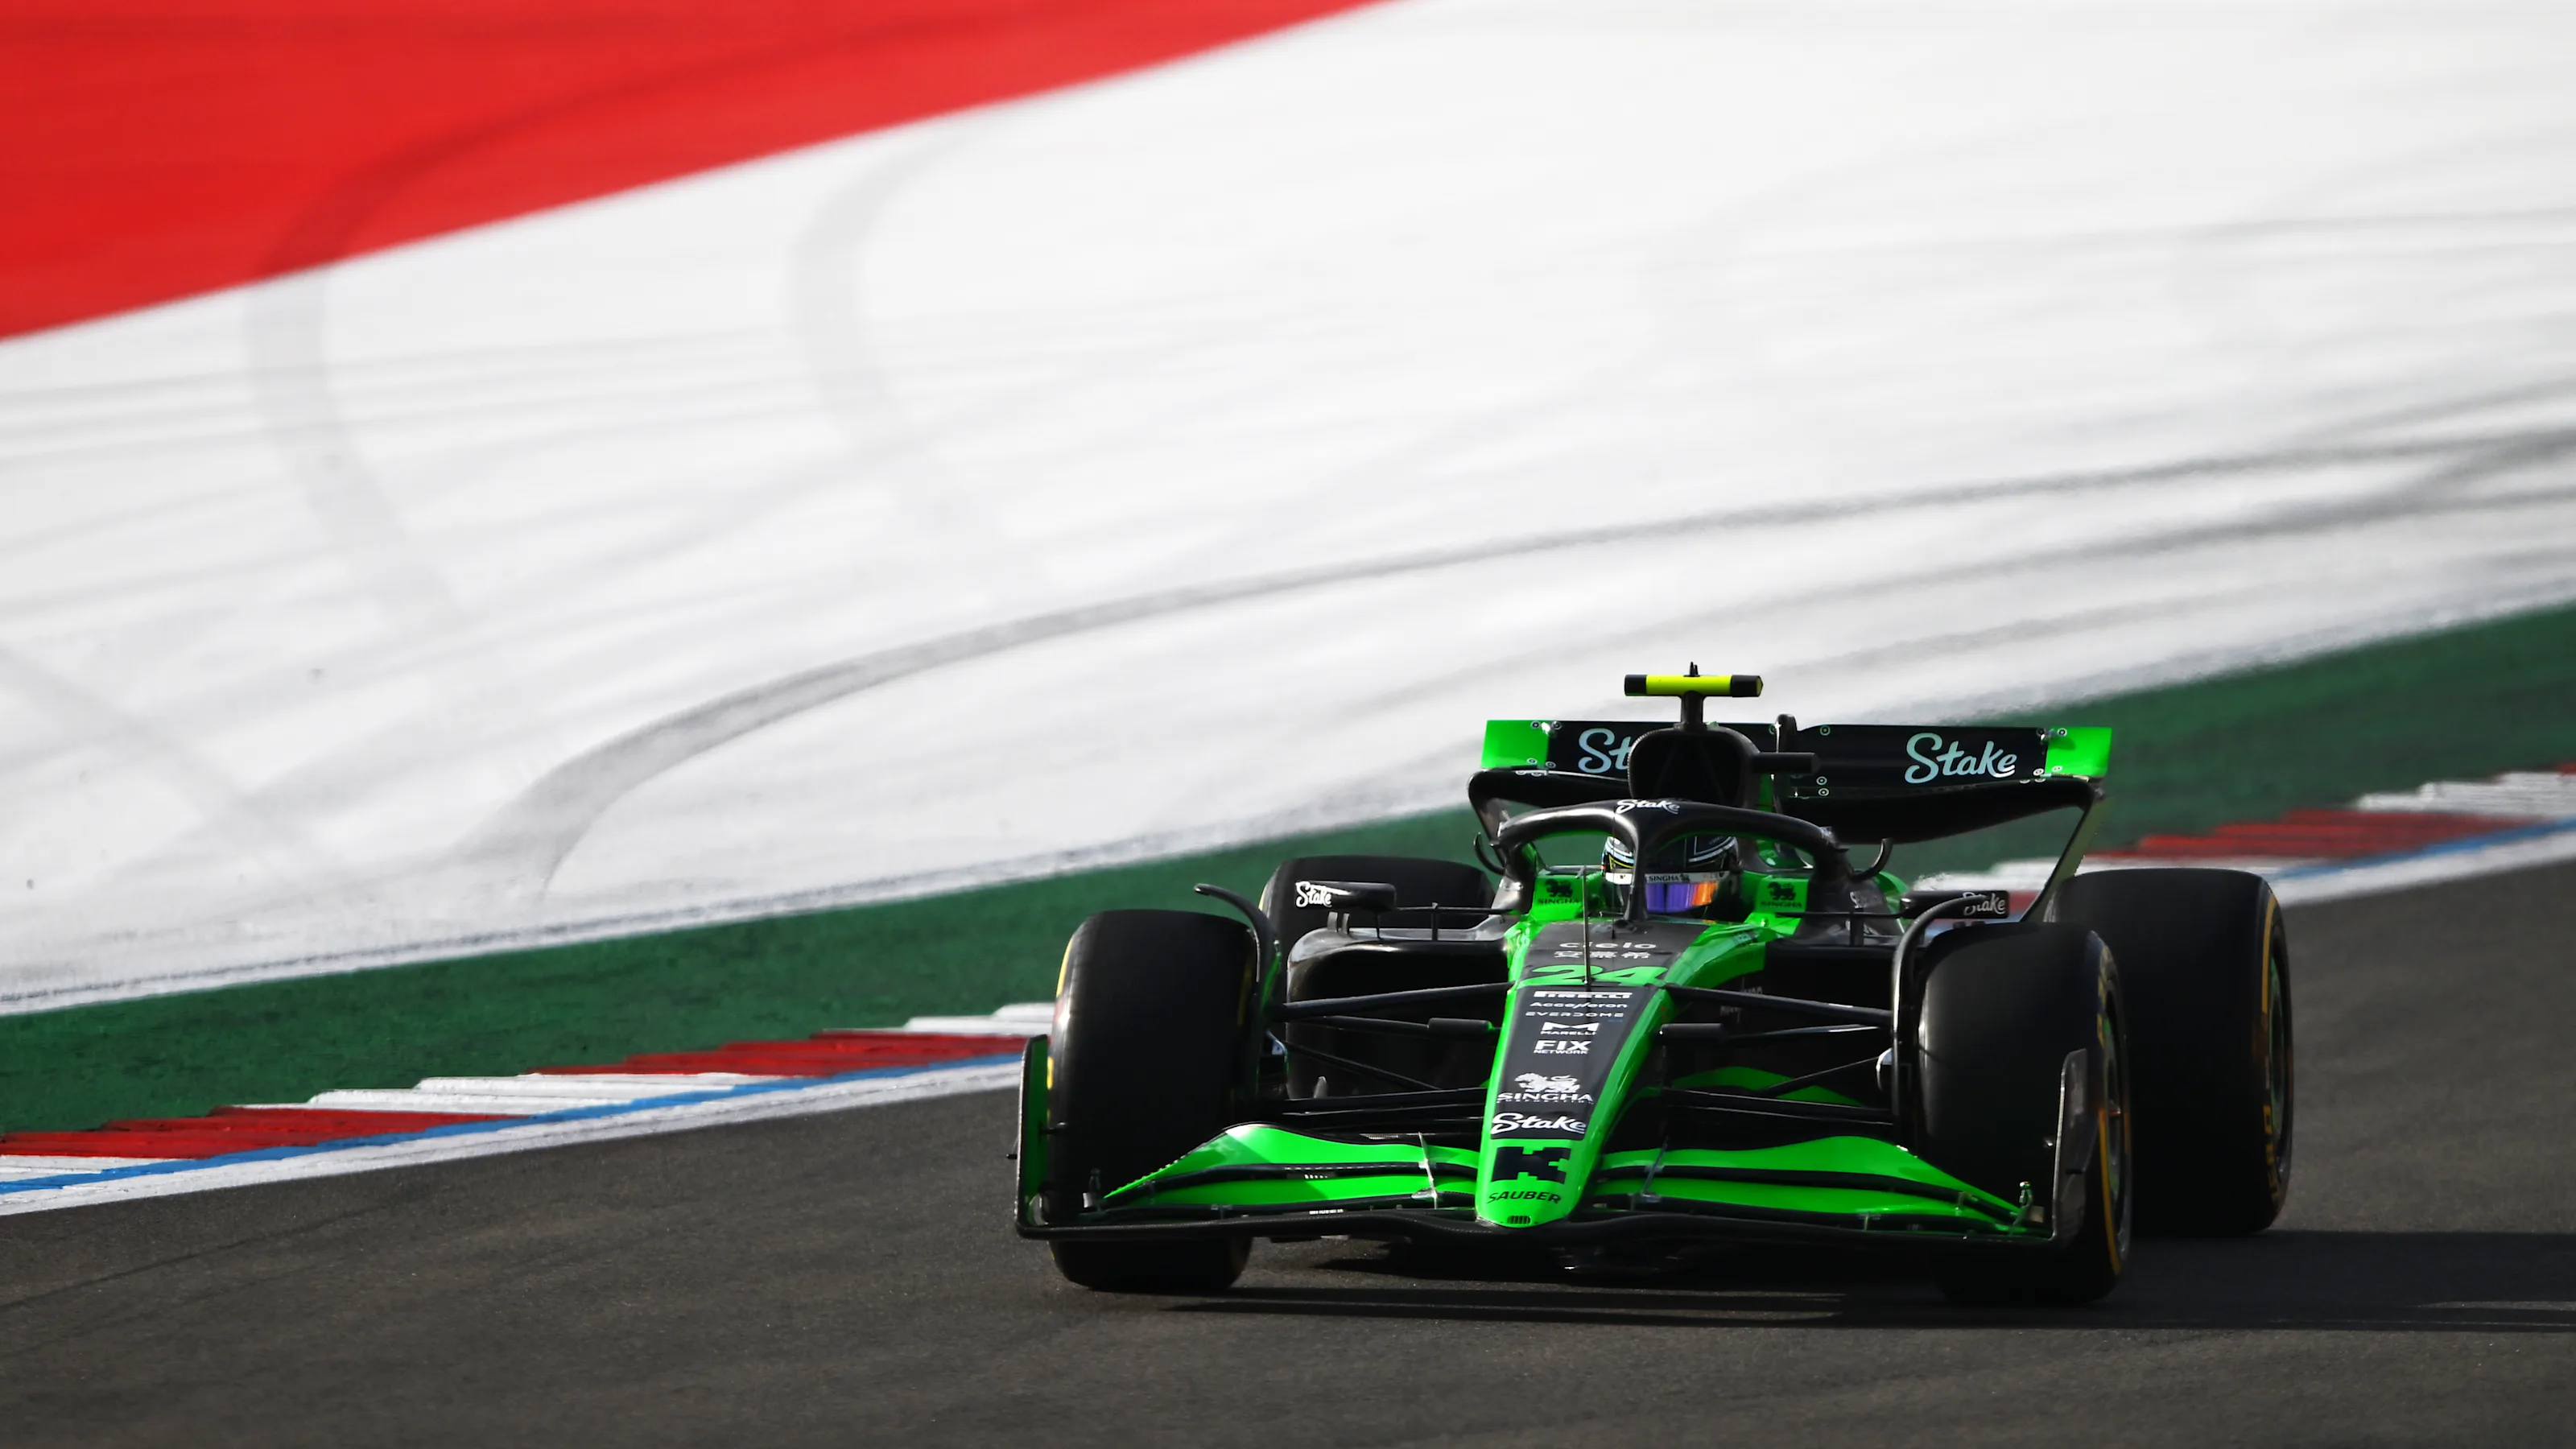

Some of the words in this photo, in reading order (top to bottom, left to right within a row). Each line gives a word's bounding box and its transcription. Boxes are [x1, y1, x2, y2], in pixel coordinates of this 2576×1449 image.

[1905, 732, 2017, 784] Stake
[1615, 799, 1681, 815] Stake
[1649, 873, 1680, 881] SINGHA
[1295, 881, 1333, 908] Stake
[1521, 964, 1669, 987] 24
[1534, 991, 1633, 999] PIRELLI
[1534, 1040, 1591, 1051] FIX
[1497, 1092, 1593, 1102] SINGHA
[1490, 1113, 1587, 1135] Stake
[1486, 1191, 1562, 1204] SAUBER
